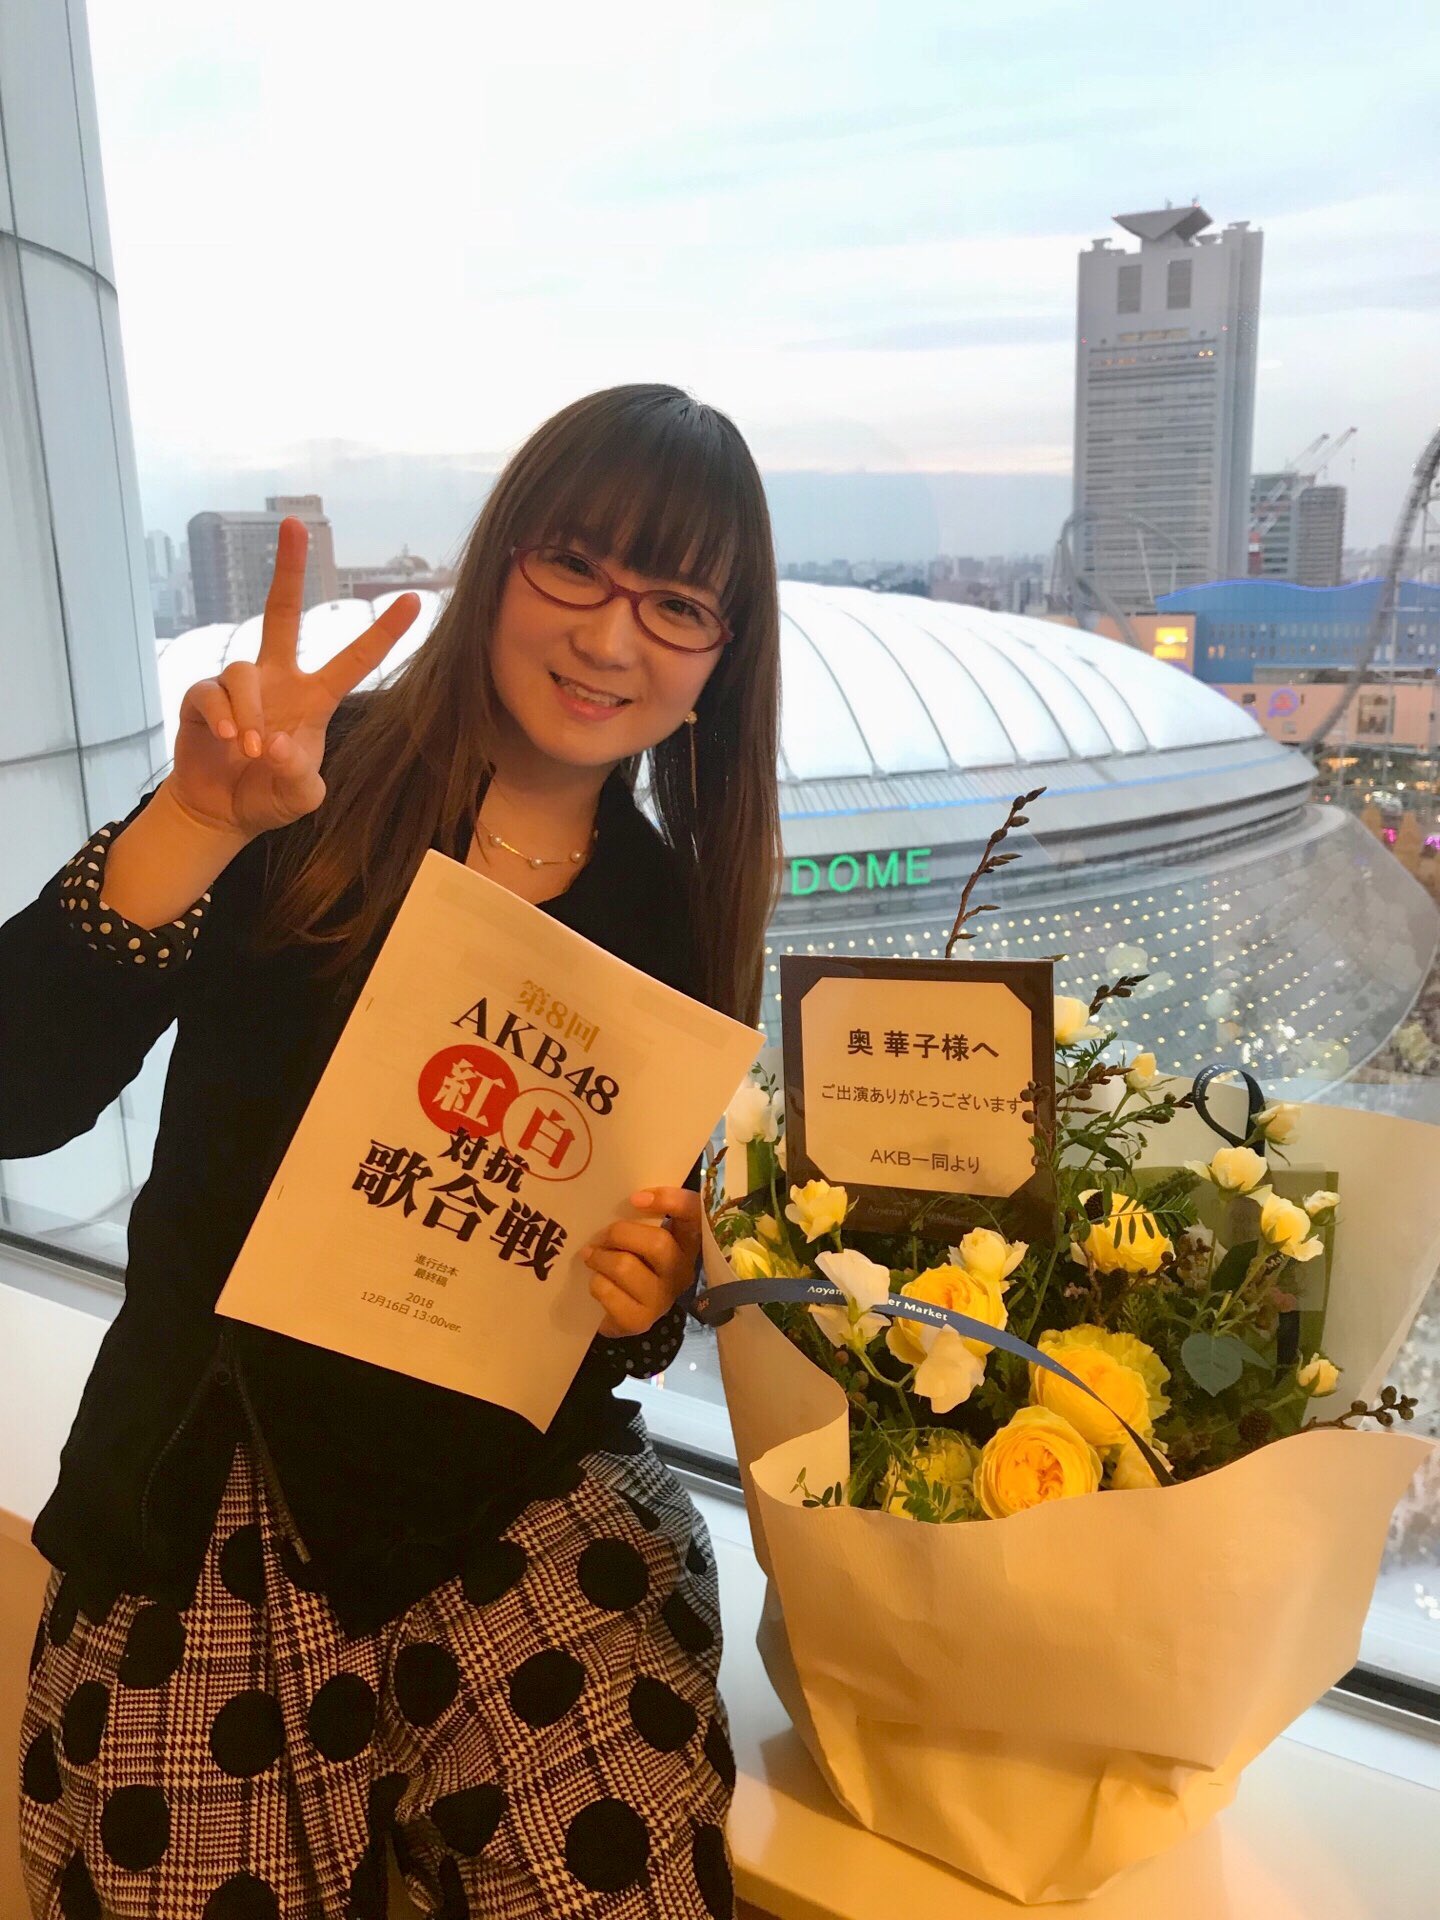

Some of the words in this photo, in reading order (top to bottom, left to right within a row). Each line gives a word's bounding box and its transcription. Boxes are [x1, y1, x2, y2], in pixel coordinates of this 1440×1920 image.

[790, 848, 932, 896] DOME
[515, 979, 601, 1053] 第8回
[450, 996, 620, 1116] AKB48
[847, 1028, 874, 1056] 奥
[883, 1030, 1000, 1062] 華子様へ
[821, 1082, 1022, 1114] ご出演ありがとうございます
[437, 1125, 531, 1194] 対抗
[870, 1149, 981, 1175] AKB一同より
[351, 1138, 568, 1282] 歌合戦
[413, 1253, 460, 1277] 進行台本
[413, 1267, 449, 1288] 最終稿
[360, 1291, 411, 1315] 12月16日
[412, 1309, 462, 1333] 13:00ver.
[405, 1291, 435, 1309] 2018
[904, 1301, 948, 1322] Market
